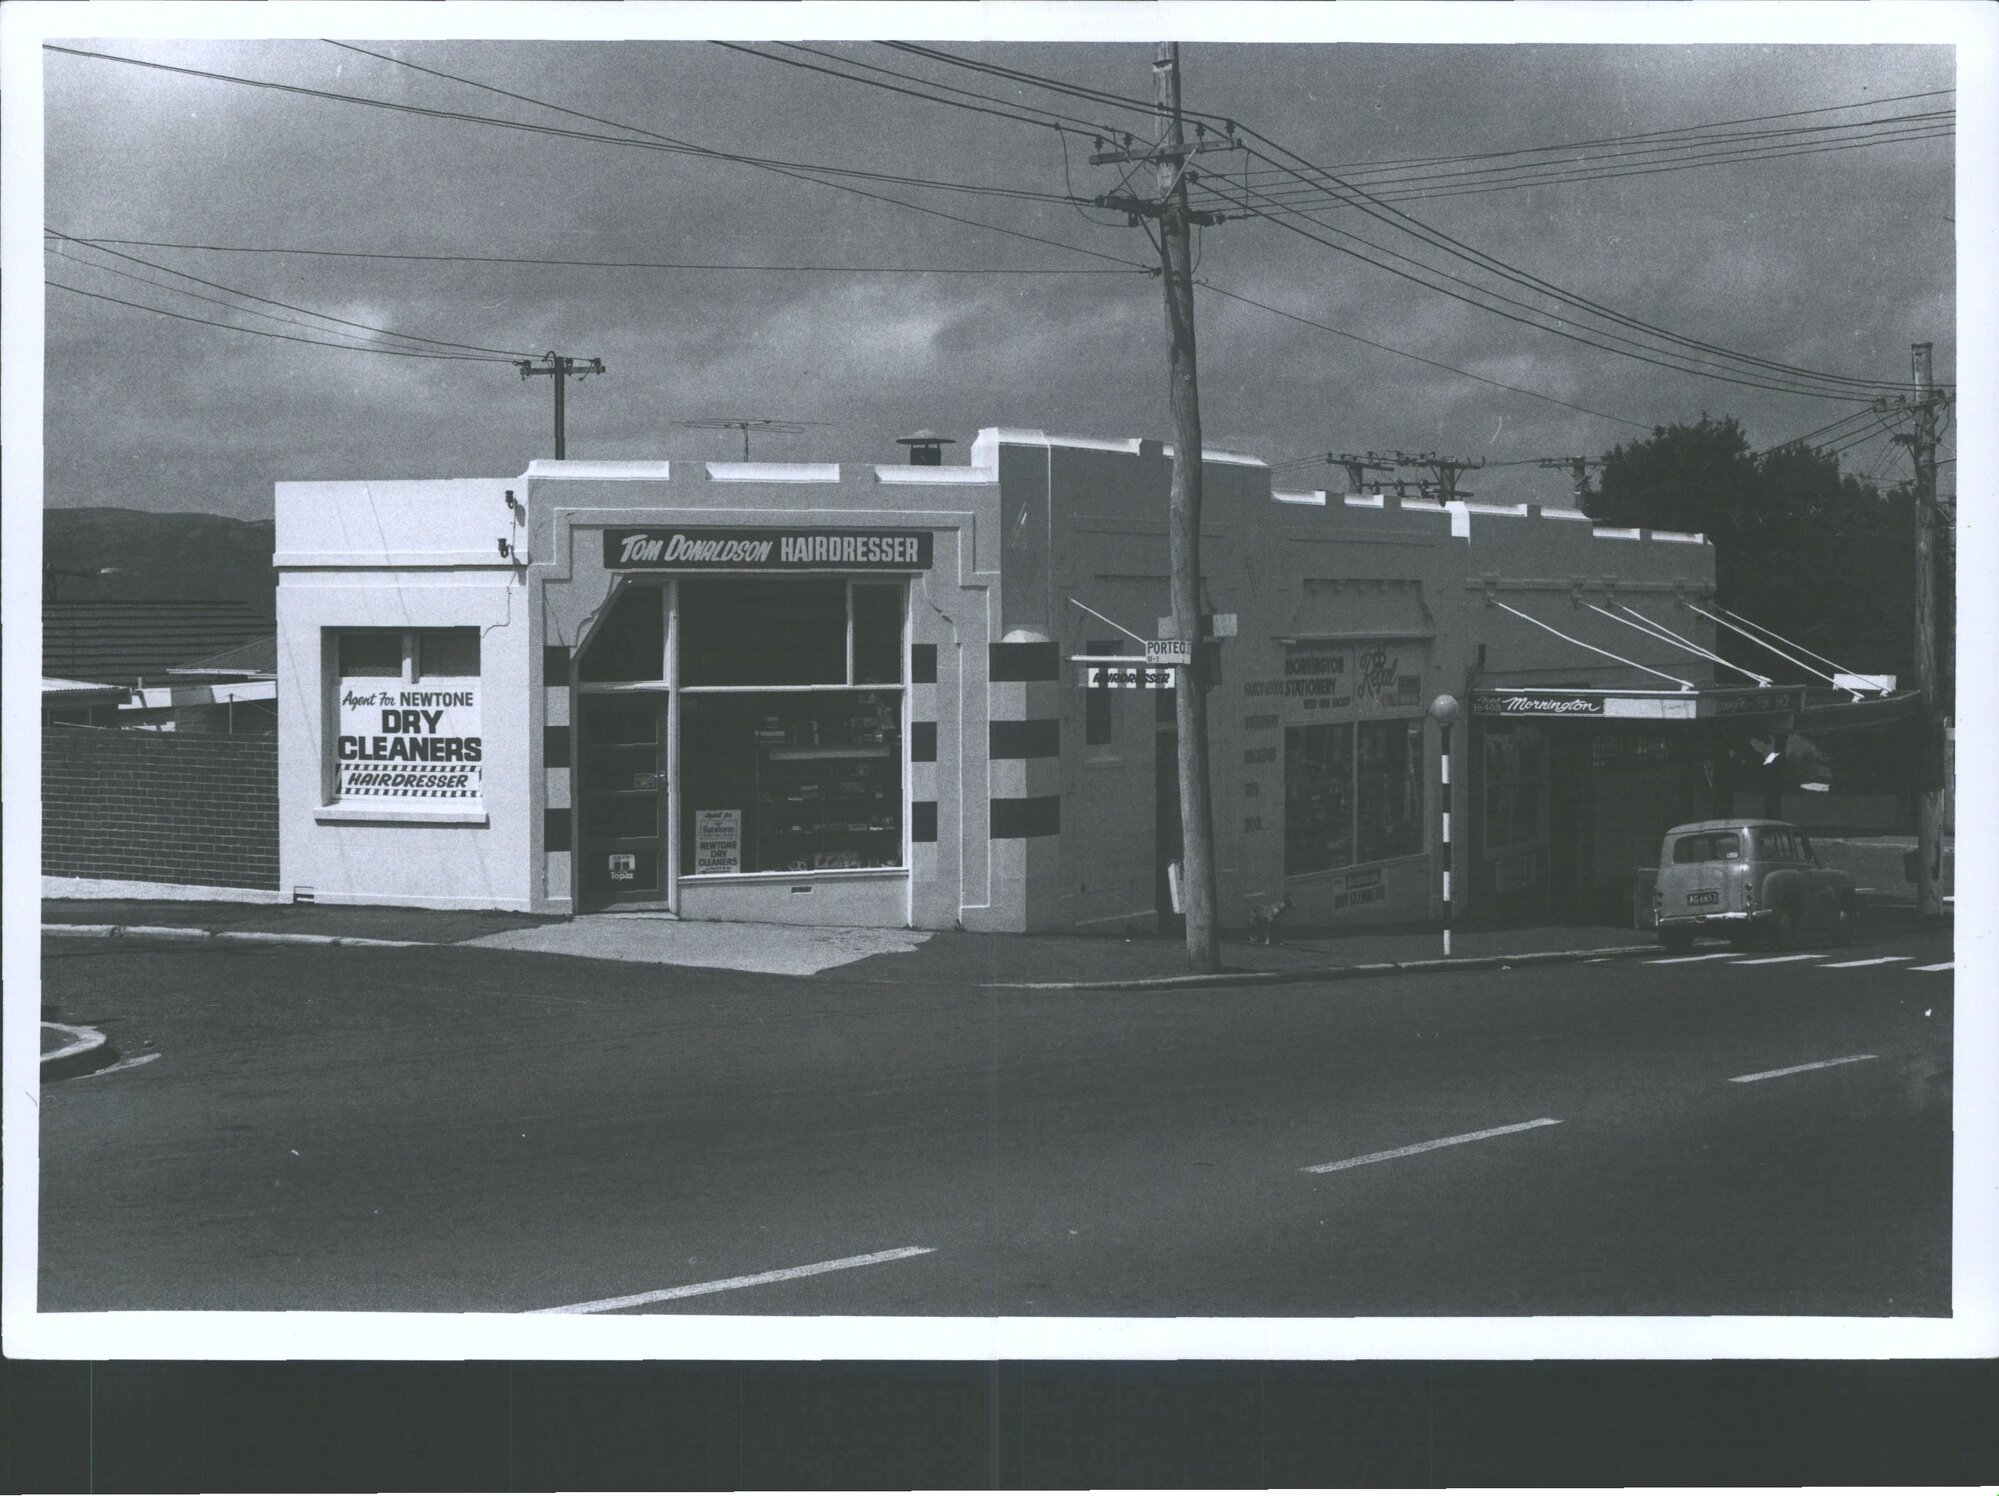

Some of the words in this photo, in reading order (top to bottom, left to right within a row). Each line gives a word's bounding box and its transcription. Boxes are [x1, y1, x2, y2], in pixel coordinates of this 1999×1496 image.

[620, 534, 664, 562] TOM
[664, 534, 773, 563] DONALDSON
[780, 536, 919, 562] HAIRDRESSER
[1147, 641, 1191, 654] PORTEO
[1285, 656, 1344, 676] MORNINGTON
[1093, 672, 1171, 684] HIRDRSSER
[1285, 678, 1336, 697] STATIONERY
[342, 690, 377, 711] Agent
[400, 691, 474, 707] NEWTONE
[1501, 696, 1601, 713] Mornington
[382, 709, 444, 735] DRY
[337, 735, 483, 762] CLEANERS
[348, 773, 469, 788] HAIRDRESSER
[700, 841, 738, 850] NEWTONE
[711, 850, 728, 858] DRY
[698, 858, 738, 867] CLEANERS
